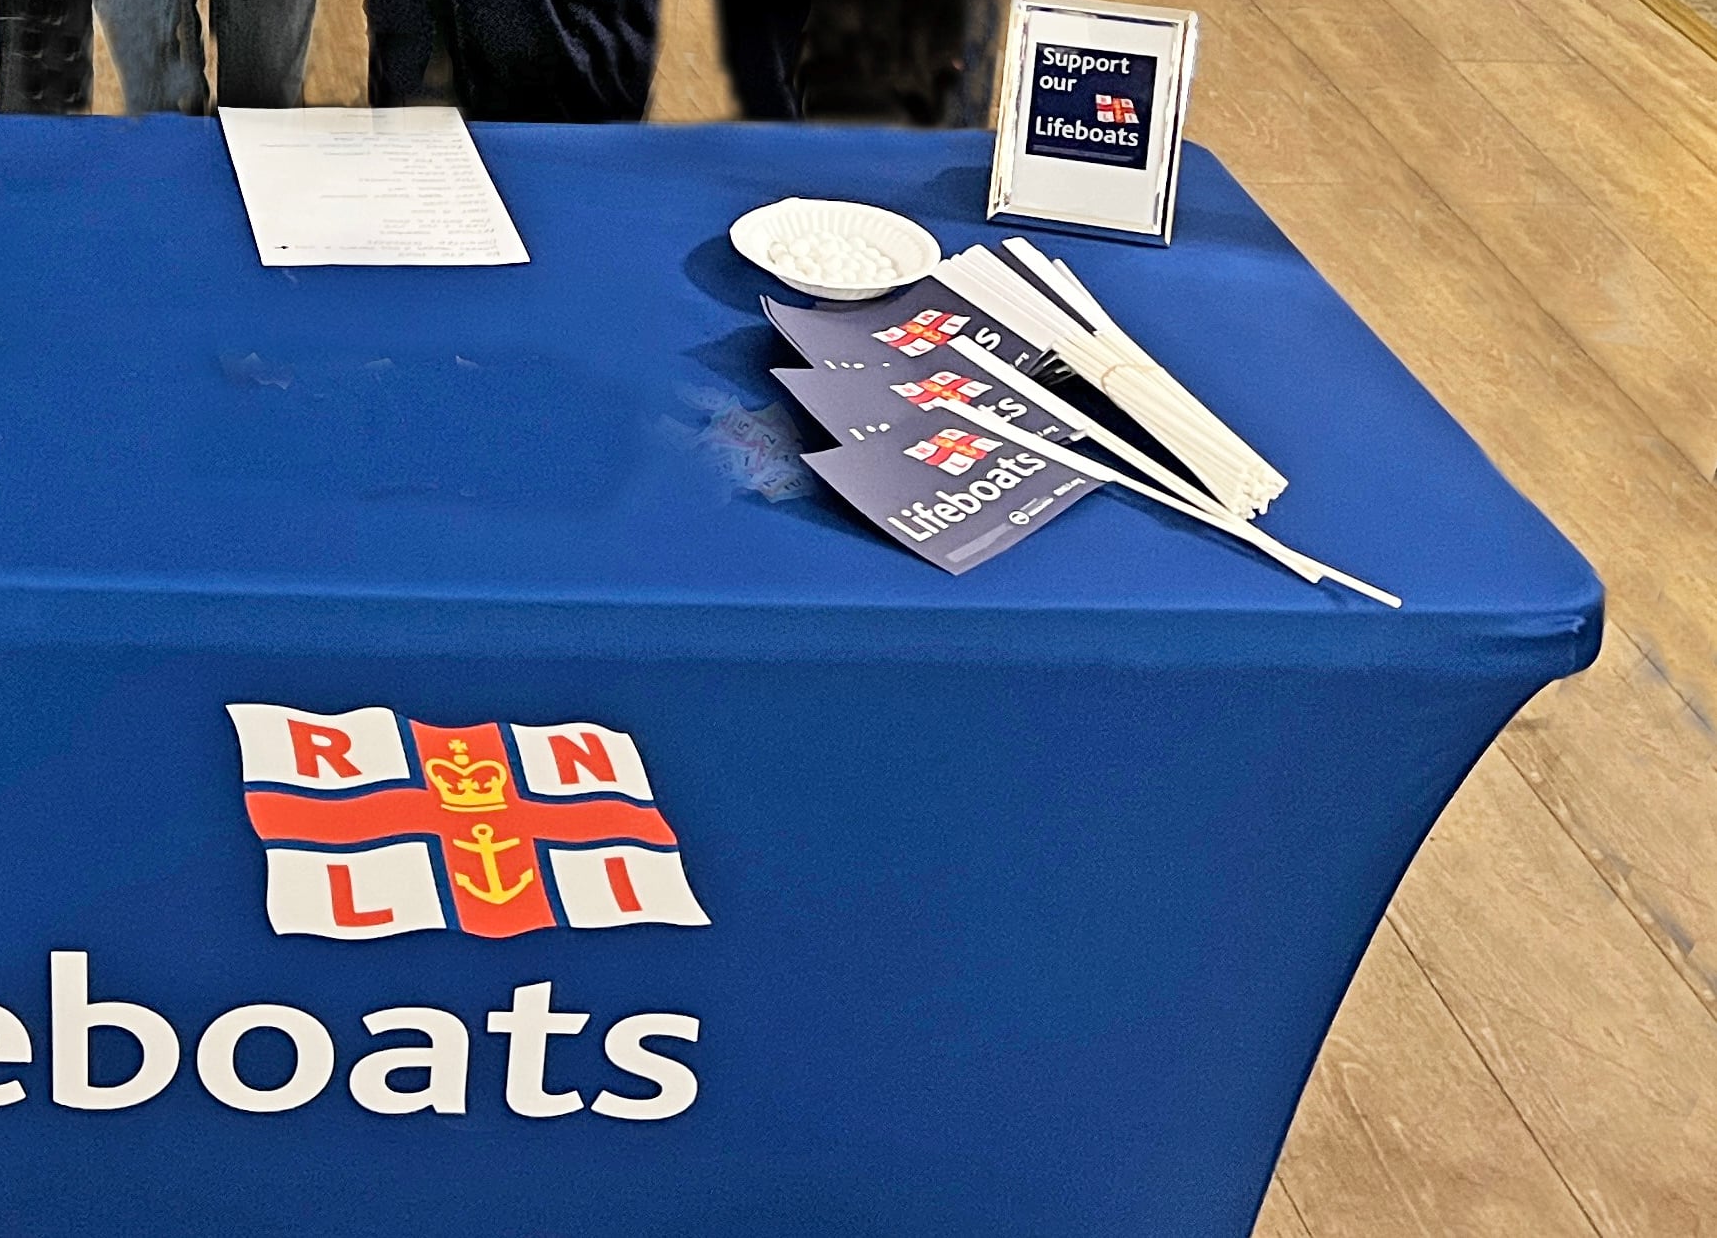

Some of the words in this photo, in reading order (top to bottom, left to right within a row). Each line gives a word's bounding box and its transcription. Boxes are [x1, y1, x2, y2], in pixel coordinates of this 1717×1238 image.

[1039, 75, 1078, 92] our
[1042, 47, 1130, 74] Support
[1035, 115, 1139, 147] Lifeboats
[887, 452, 1047, 542] Lifeboats
[286, 717, 362, 780] R
[547, 731, 618, 783] N
[326, 862, 393, 927] L
[603, 856, 643, 913] I
